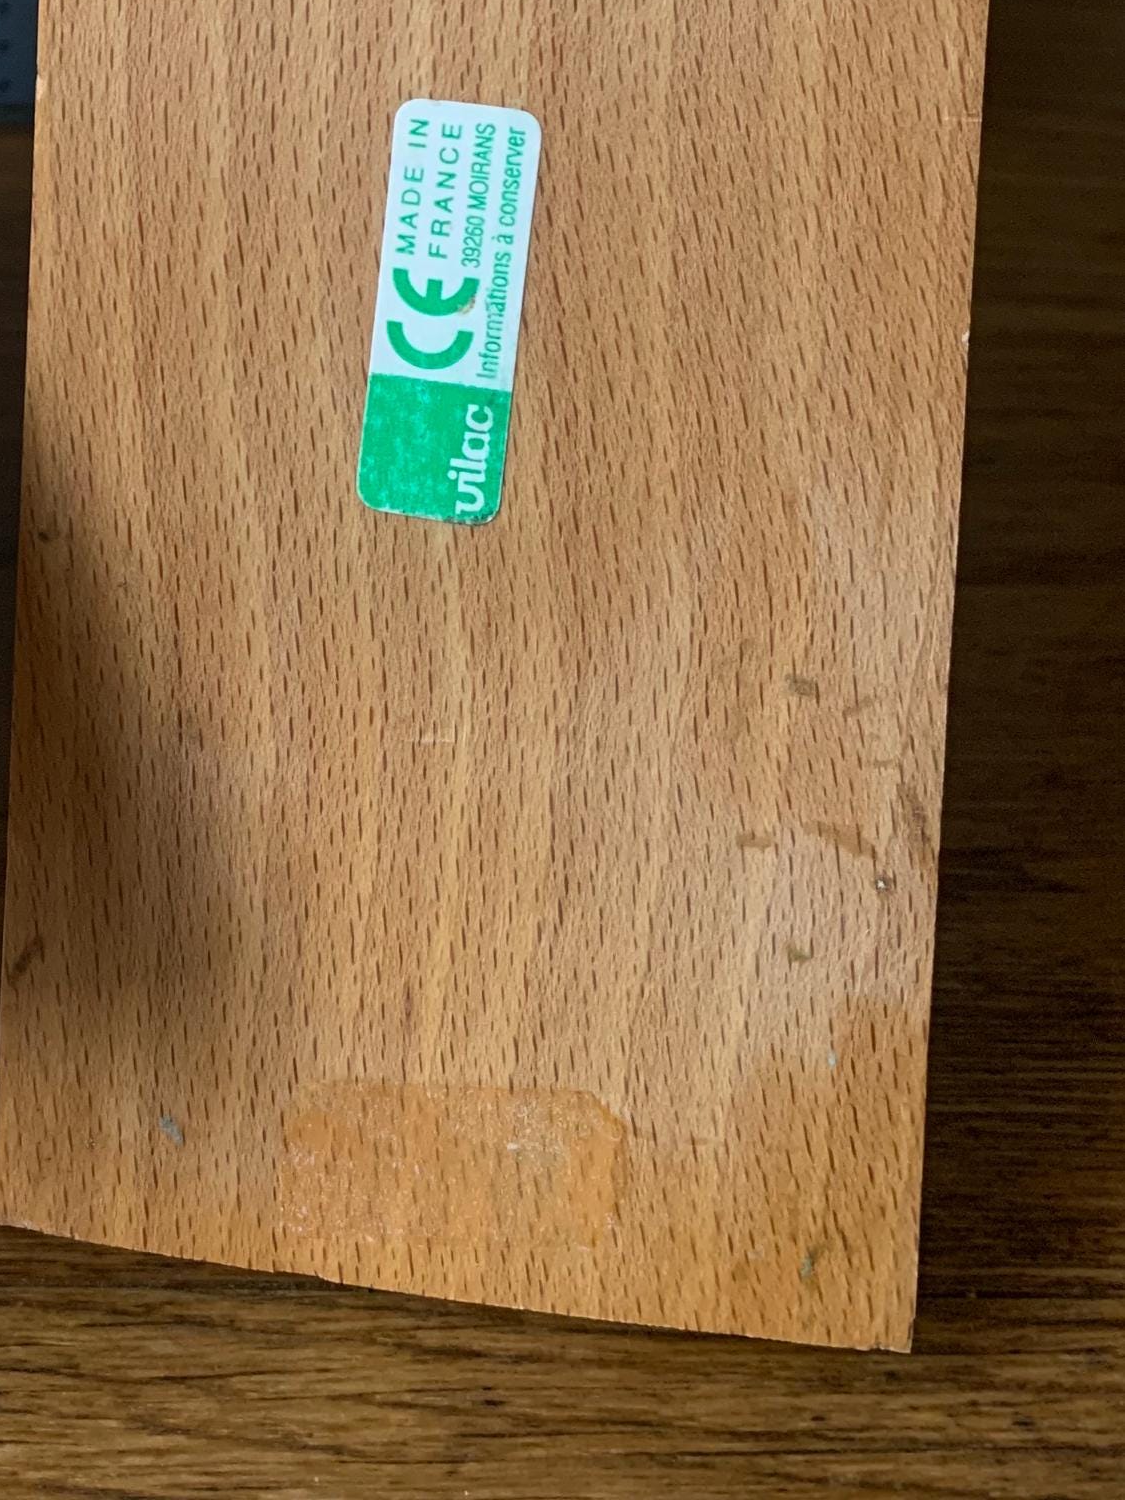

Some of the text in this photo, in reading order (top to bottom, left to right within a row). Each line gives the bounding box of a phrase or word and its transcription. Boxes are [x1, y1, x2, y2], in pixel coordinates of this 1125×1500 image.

[395, 118, 430, 256] MADE IN
[428, 123, 463, 260] FRANCE
[461, 123, 497, 269] 39260 MOIRANS
[475, 125, 528, 380] Informations à conserver
[447, 403, 494, 517] vilac
